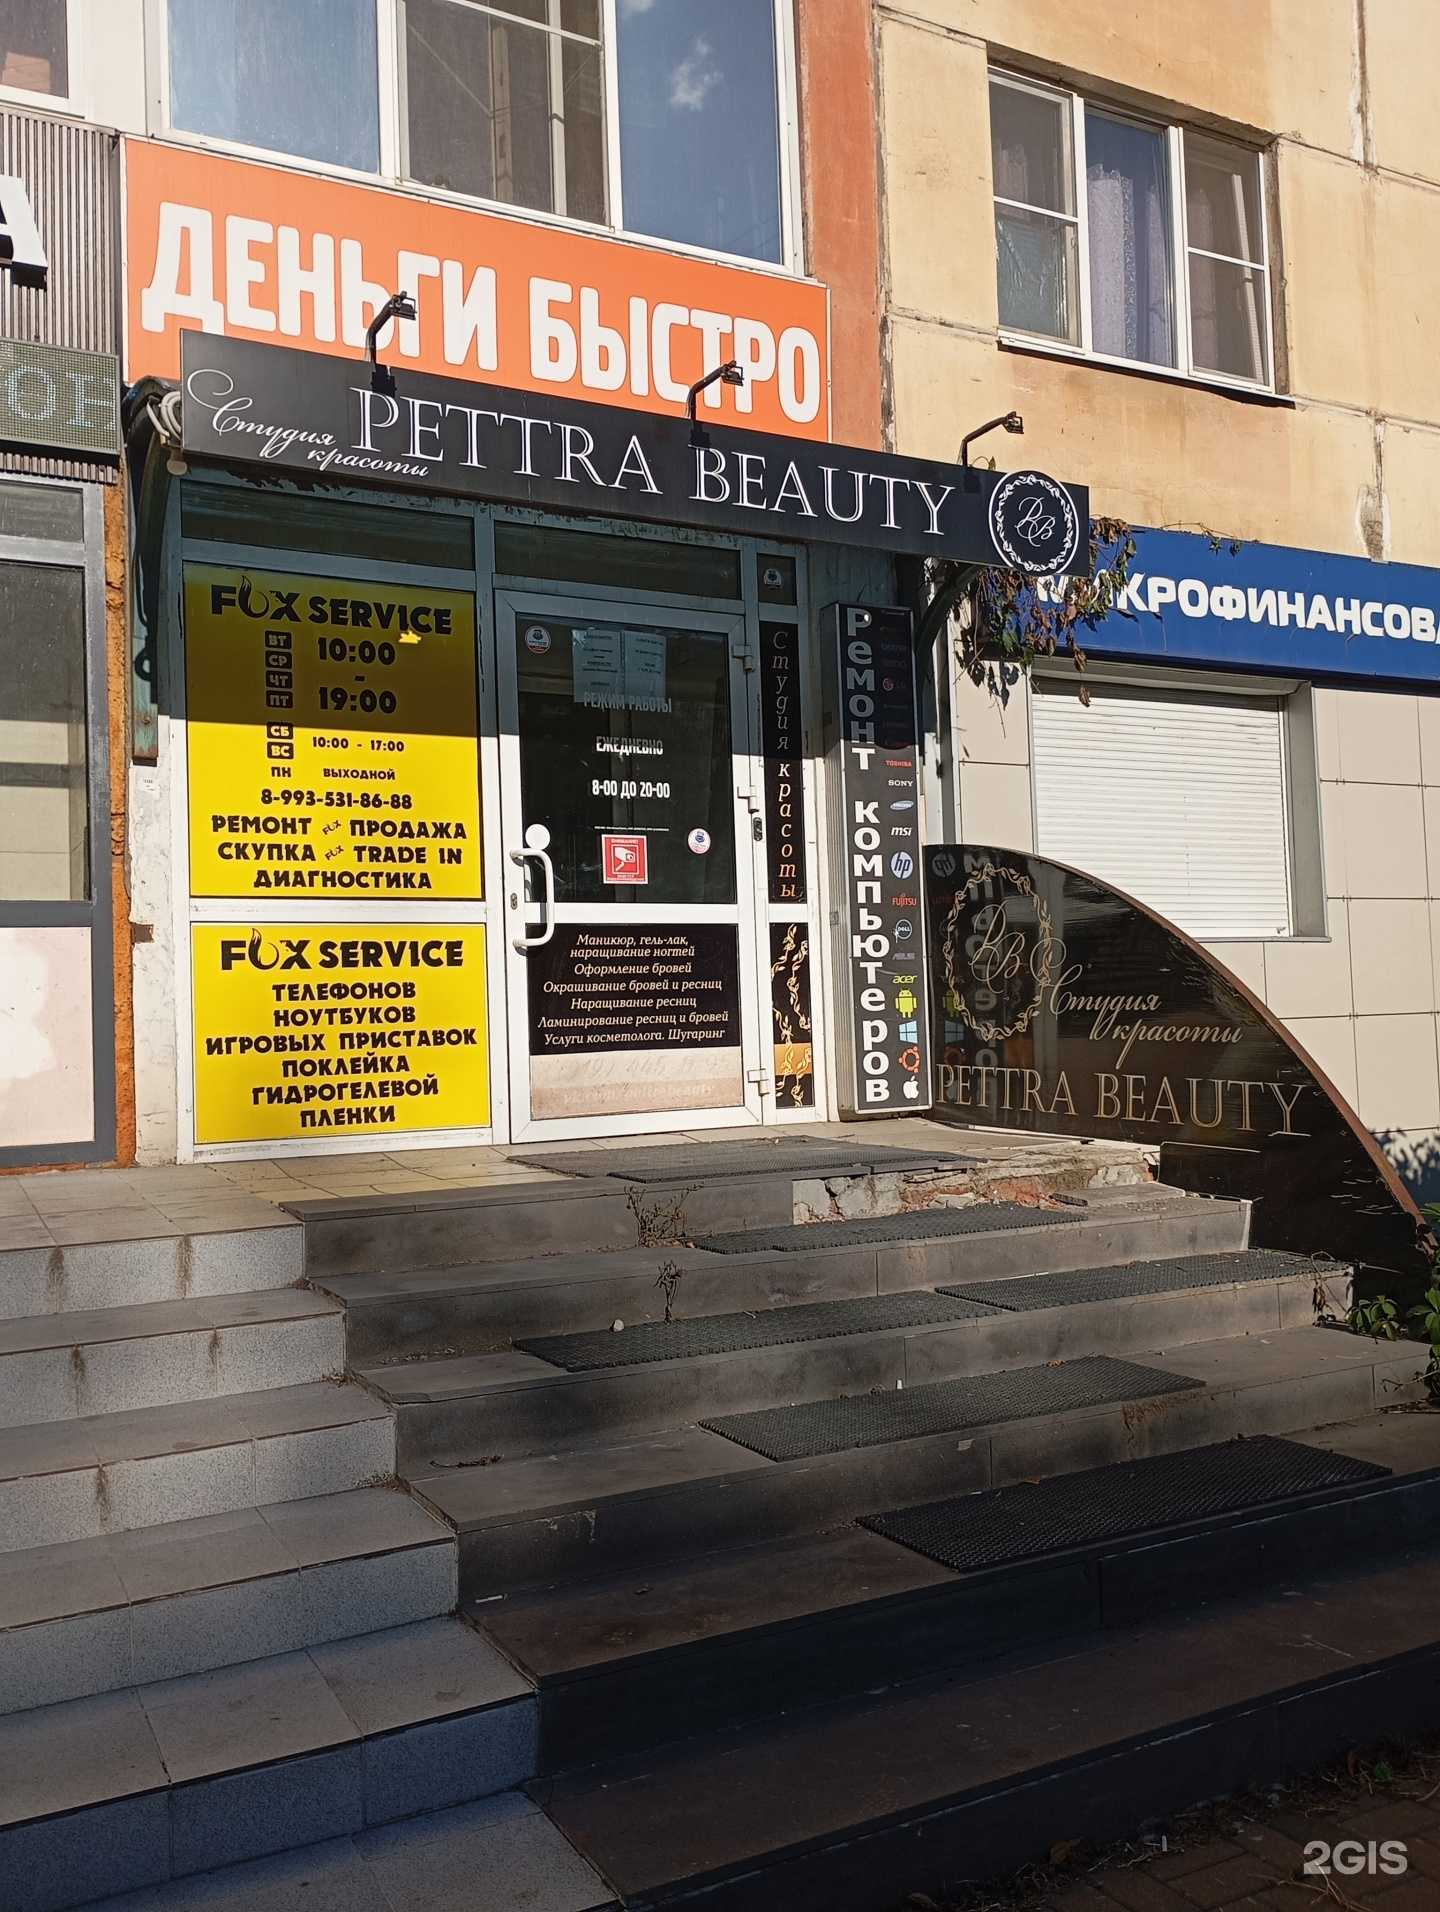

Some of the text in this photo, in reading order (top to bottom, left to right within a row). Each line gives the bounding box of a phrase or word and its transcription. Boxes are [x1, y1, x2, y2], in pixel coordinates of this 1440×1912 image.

[141, 201, 821, 424] ДЕНЬГИ БЫСТРО
[187, 369, 336, 459] Студия
[307, 448, 429, 477] красоты
[349, 387, 956, 535] PETTRA BEAUTY
[308, 595, 452, 635] SERVICE
[317, 637, 396, 665] 10:00
[318, 686, 397, 714] 19:00
[270, 725, 290, 738] СБ
[271, 745, 290, 758] ВС
[312, 736, 349, 749] 10:00
[370, 740, 404, 752] 17:00
[596, 735, 664, 756] ЕЖЕДНЕВНО
[271, 766, 396, 781] ПН ВЫХОДНОЙ
[772, 631, 797, 898] Студия красоты
[592, 780, 670, 799] 8-00 ДО 20-00
[887, 779, 914, 787] SONY
[260, 789, 412, 809] 8-993-531-86-88
[211, 815, 312, 835] РЕМОНТ
[349, 819, 467, 840] ПРОДАЖА
[891, 826, 913, 837] msi
[217, 842, 316, 861] СКУПКА
[353, 845, 427, 864] TRADE
[438, 848, 463, 865] IN
[846, 607, 891, 1102] Ремонт компьютеров
[893, 855, 911, 876] hp
[253, 870, 432, 889] ДИАГНОСТИКА
[576, 934, 689, 947] Маникюр, гель-лак,
[318, 940, 464, 968] SERVICE
[570, 946, 695, 959] наращивание ногтей
[574, 963, 692, 977] Оформление бровей
[892, 975, 917, 984] acer
[272, 981, 416, 1001] ТЕЛЕФОНОВ
[543, 979, 722, 995] Окрашивание бровей и ресниц
[1030, 938, 1162, 1040] Студия
[571, 998, 697, 1011] Наращивание ресниц
[273, 1006, 416, 1027] НОУТБУКОВ
[537, 1011, 729, 1029] Ламинирование ресниц и бровей
[205, 1028, 478, 1055] ИГРОВЫХ ПРИСТАВОК
[544, 1029, 725, 1047] Услуги косметолога. Шугаринг
[1112, 1019, 1242, 1069] красоты
[282, 1052, 410, 1078] ПОКЛЕЙКА
[252, 1073, 439, 1105] ГИДРОГЕЛЕВОЙ
[936, 1064, 1311, 1137] PETTRA BEAUTY
[300, 1105, 396, 1128] ПЛЕНКИ
